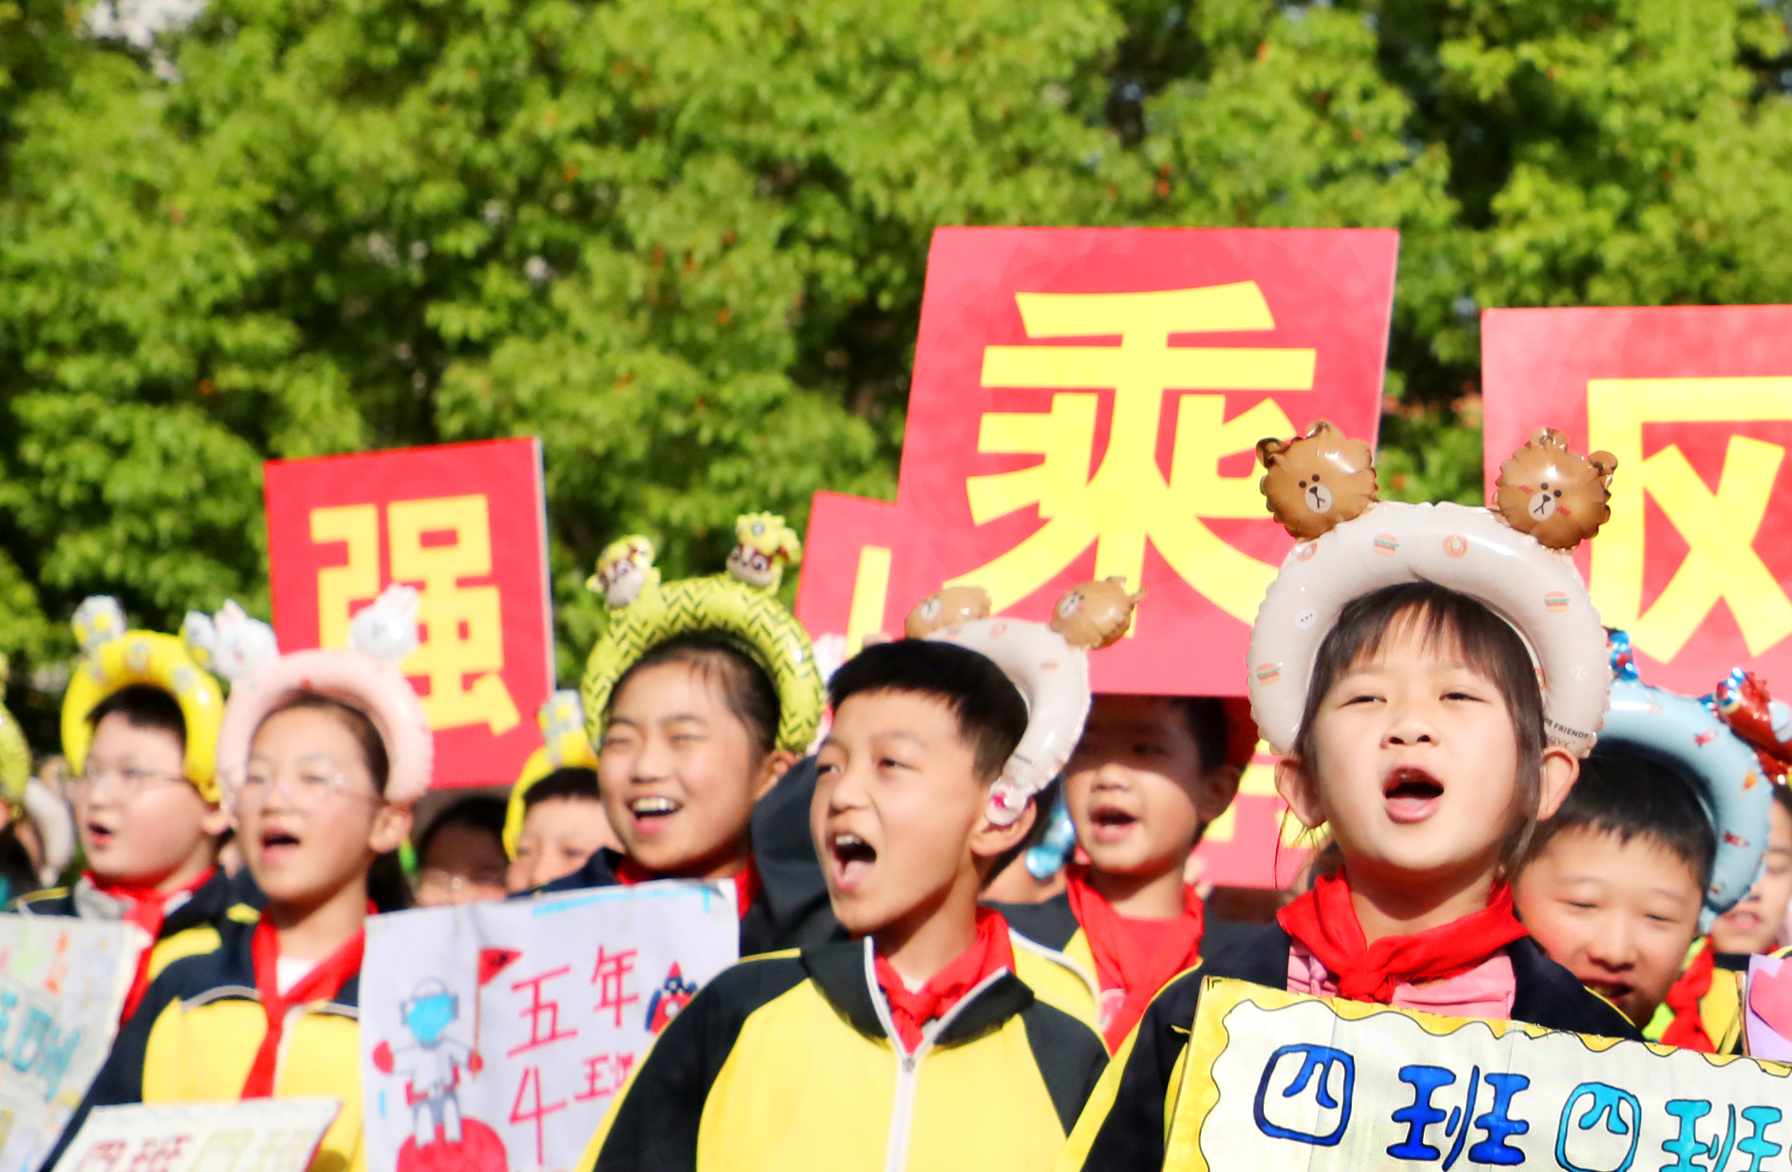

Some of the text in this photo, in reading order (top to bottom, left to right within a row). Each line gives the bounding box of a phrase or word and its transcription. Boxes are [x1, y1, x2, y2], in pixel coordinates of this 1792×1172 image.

[944, 280, 1316, 640] 乘
[309, 494, 521, 736] 强
[508, 944, 640, 1058] 五年
